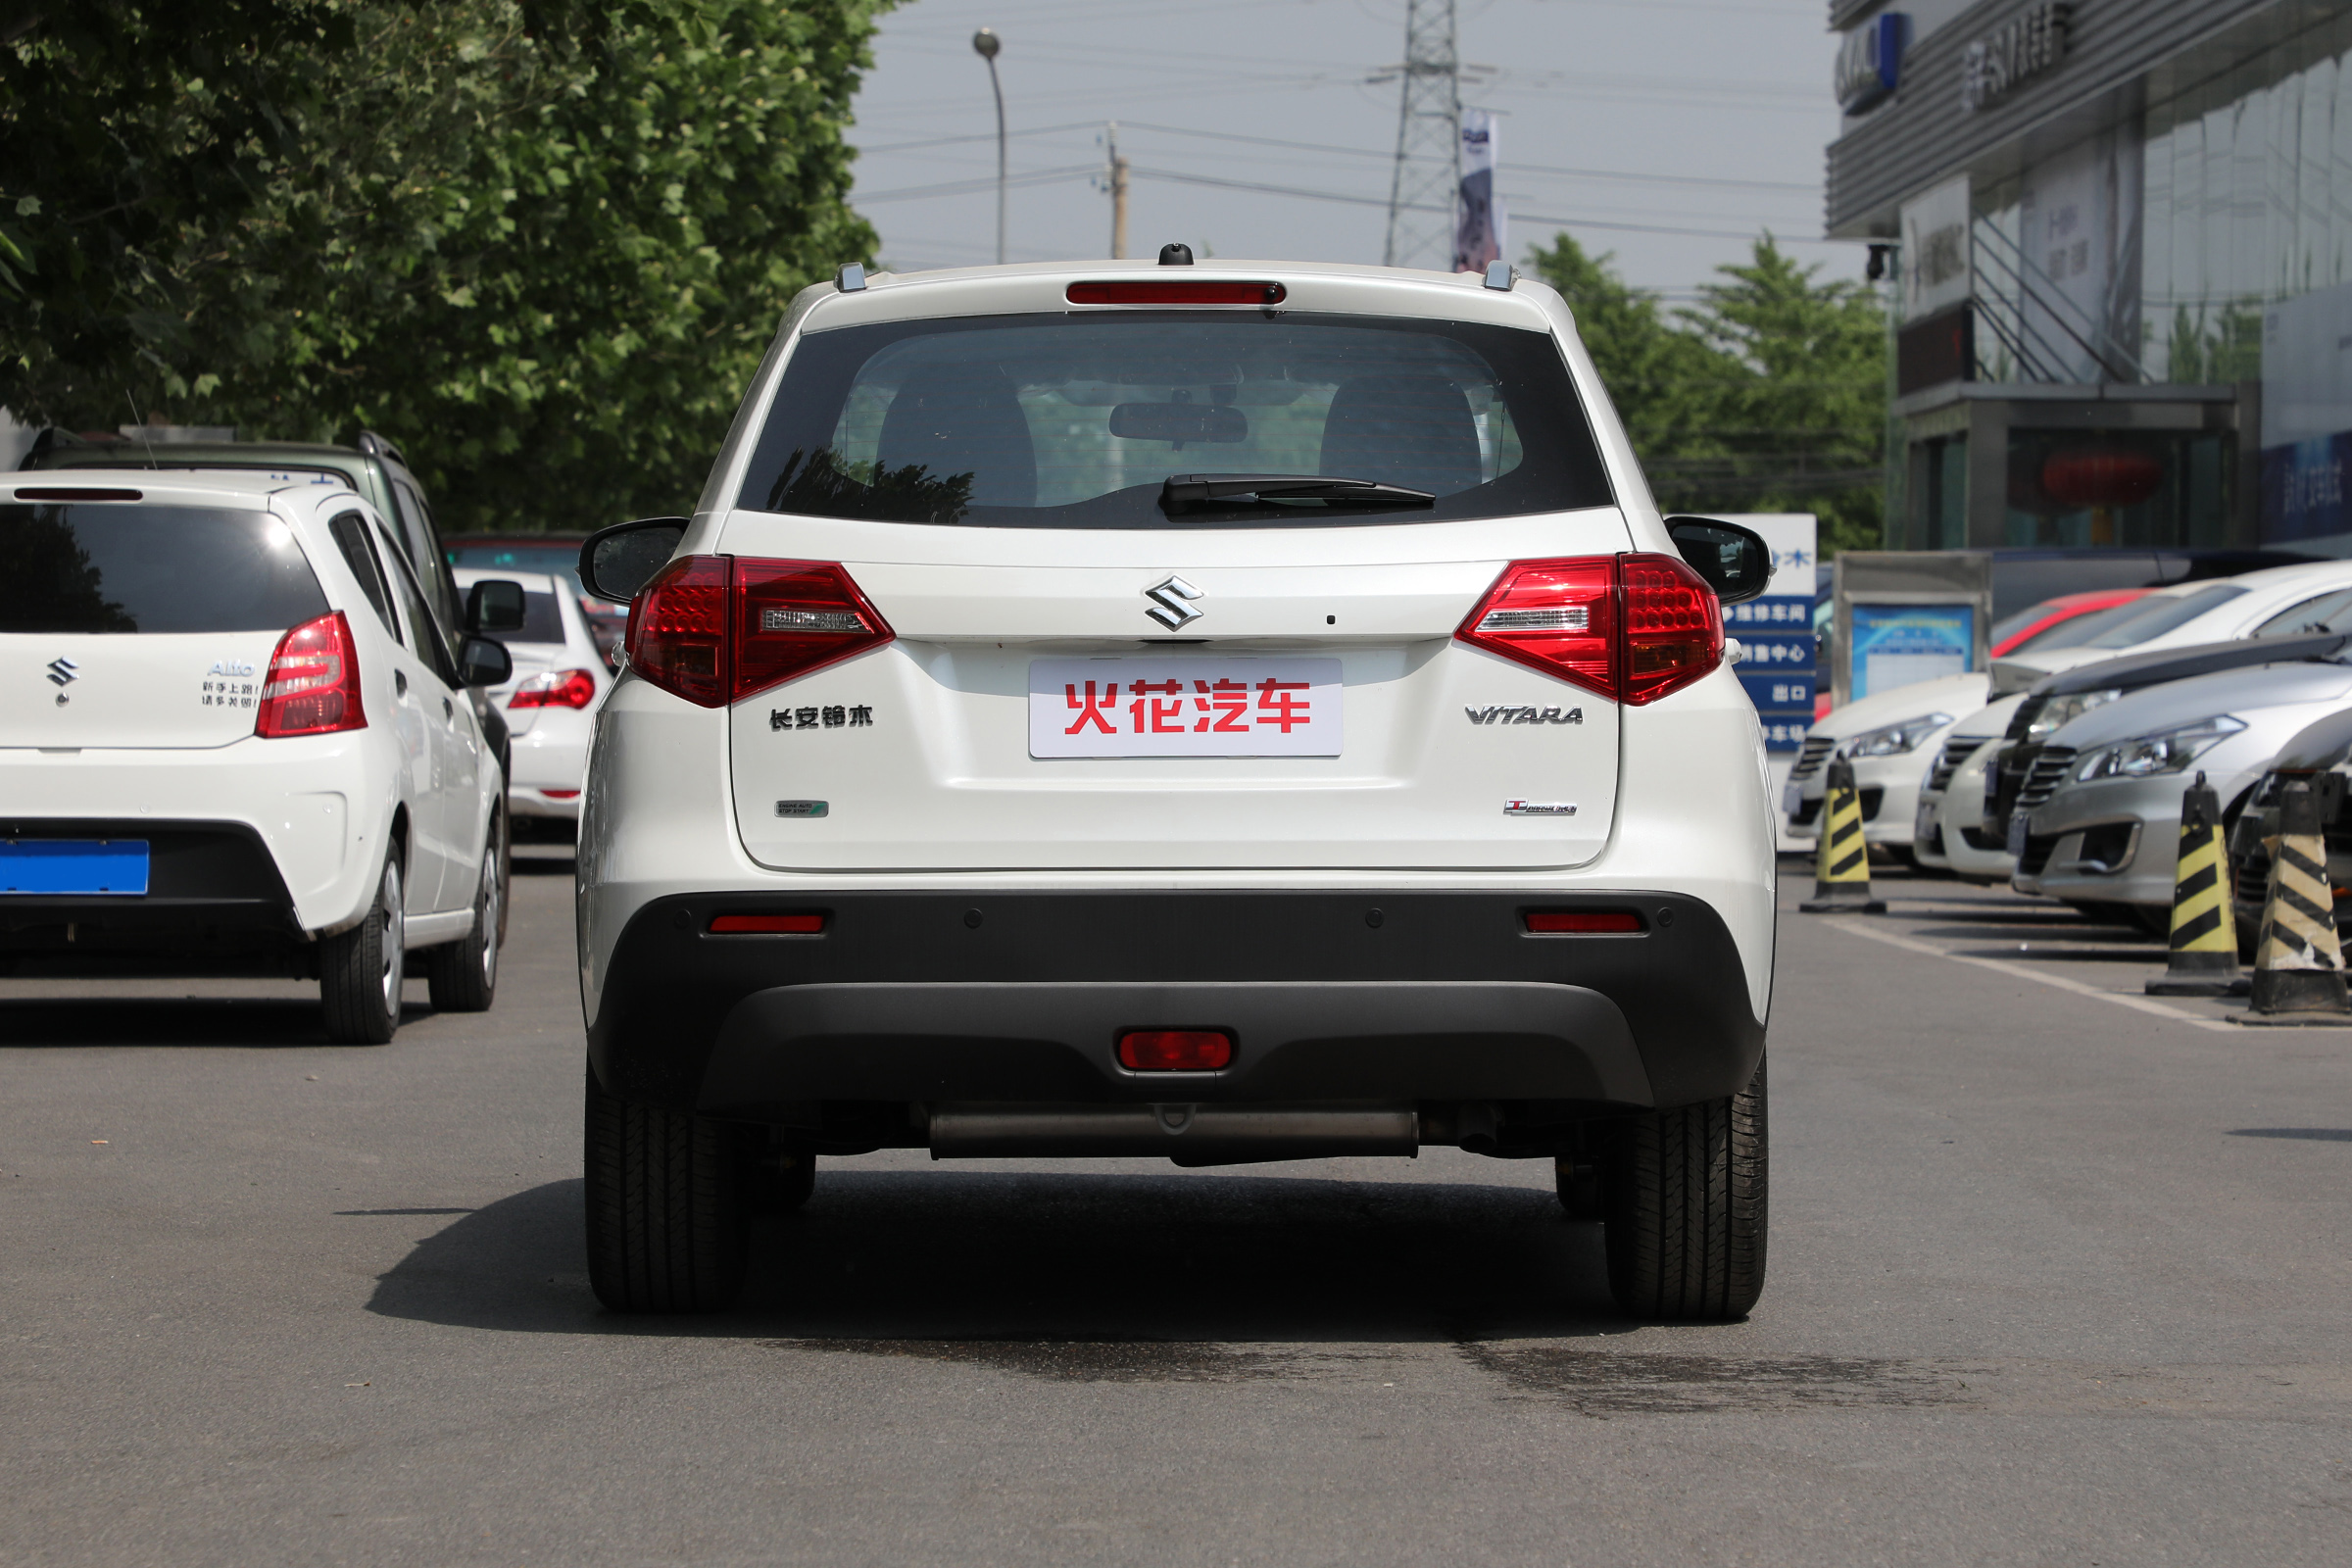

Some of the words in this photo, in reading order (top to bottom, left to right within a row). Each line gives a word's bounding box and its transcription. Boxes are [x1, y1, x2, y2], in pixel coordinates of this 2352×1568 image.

[1772, 549, 1812, 568] 木
[1735, 604, 1806, 622] 维修车间
[207, 659, 256, 677] Alto
[1772, 684, 1806, 703] 出口
[1064, 677, 1311, 735] 火花汽车
[1464, 705, 1584, 725] VITARA
[769, 705, 874, 732] 长安铃木
